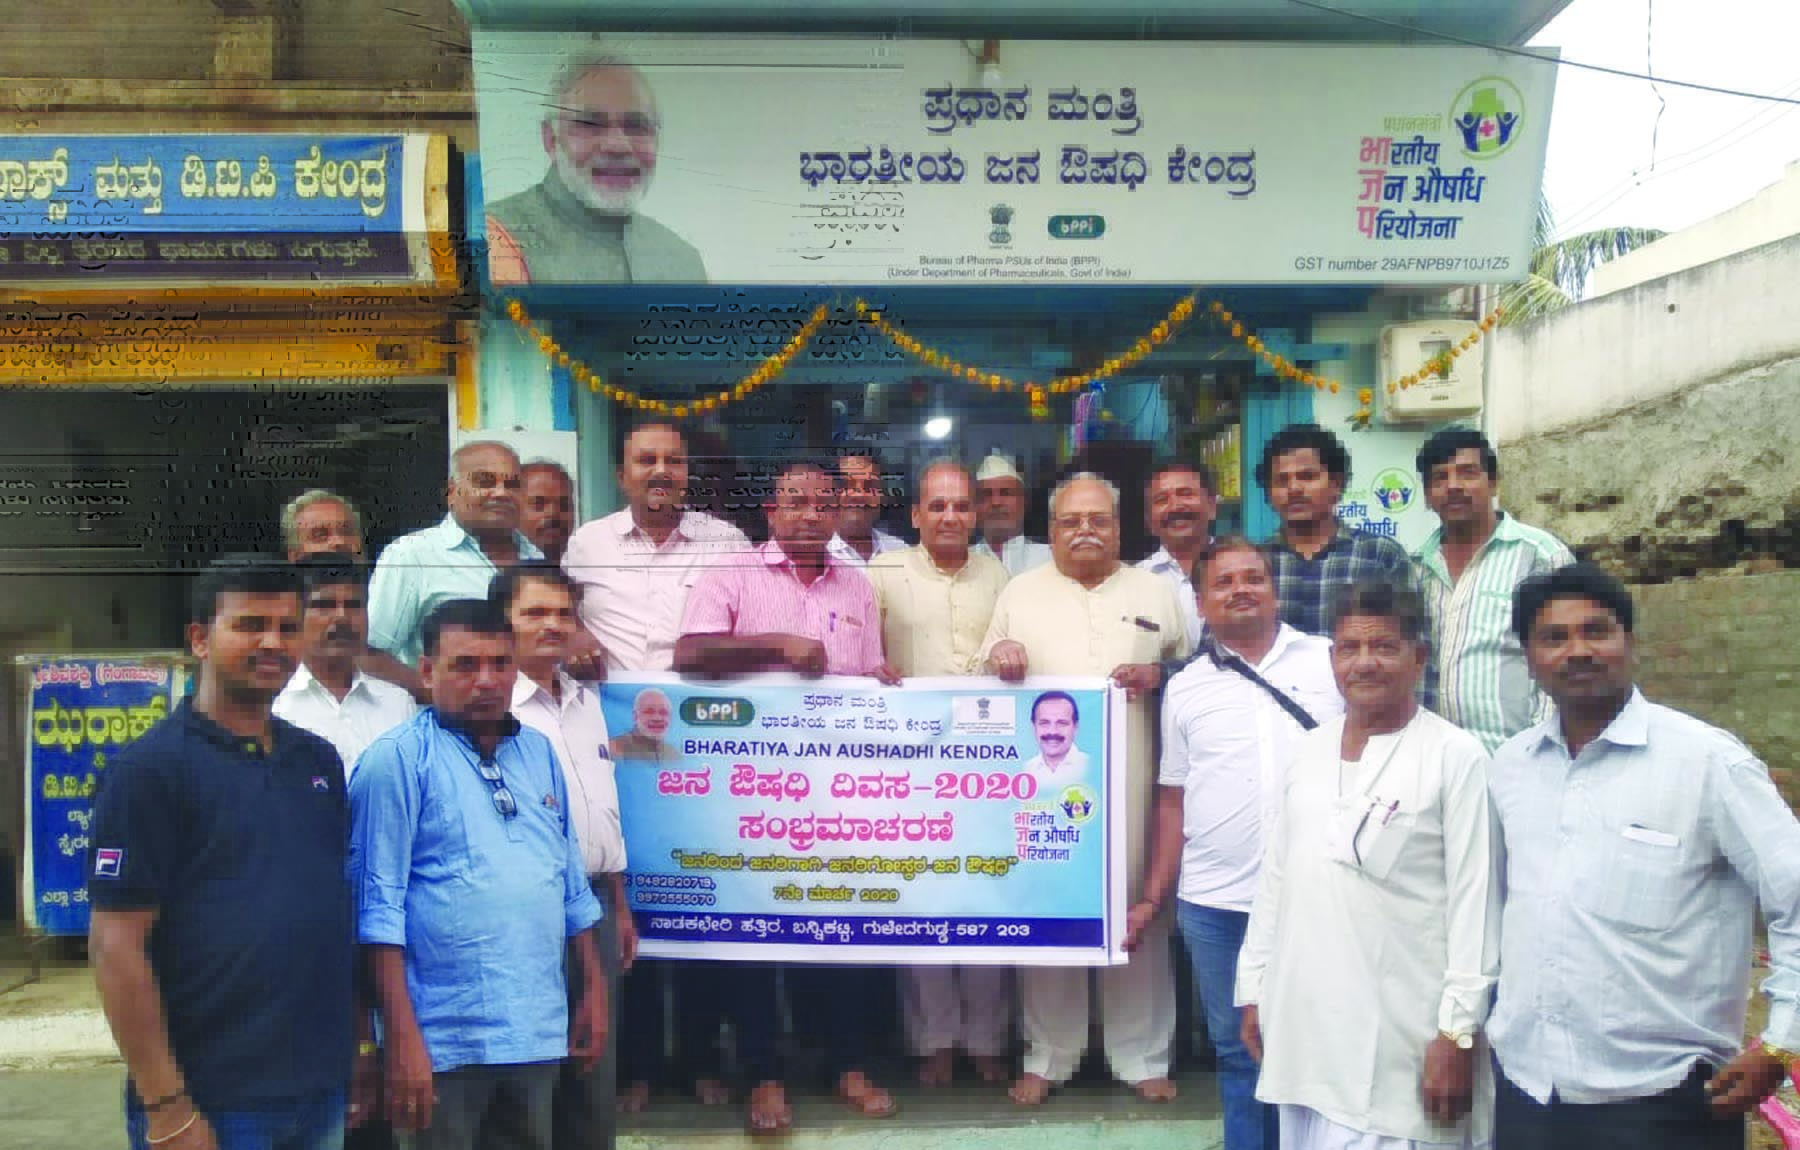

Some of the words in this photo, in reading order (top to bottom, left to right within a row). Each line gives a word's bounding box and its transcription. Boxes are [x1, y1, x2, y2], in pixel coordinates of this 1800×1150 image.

[924, 82, 1029, 133] ಪ್ರಧಾನ
[1048, 85, 1142, 135] ಮಂತ್ರಿ
[1359, 135, 1441, 165] भारतीय
[95, 156, 163, 215] ಮತ್ತು
[294, 145, 388, 218] ಕೇಂದ್ರ
[799, 145, 965, 188] ಭಾರತೀಯ
[986, 148, 1040, 184] ಜನ
[1060, 146, 1147, 190] ಔಷಧಿ
[1168, 147, 1257, 196] ಕೇಂದ್ರ
[1357, 168, 1408, 203] जन
[1411, 167, 1486, 203] औषधि
[1356, 206, 1464, 240] परियोजना
[887, 267, 919, 278] (Under
[922, 267, 976, 278] Department
[978, 267, 987, 278] of
[919, 255, 953, 266] Bureau
[955, 255, 965, 266] of
[967, 255, 1003, 266] Pharma
[1034, 255, 1044, 266] of
[1046, 255, 1068, 266] India
[1070, 255, 1101, 266] (BPPI)
[1294, 256, 1324, 270] GST
[1328, 257, 1377, 270] number
[803, 694, 844, 711] ಪ್ರಧಾನ
[850, 695, 888, 713] ಮಂತ್ರಿ
[761, 715, 826, 729] ಭಾರತೀಯ
[834, 717, 857, 730] ಜನ
[864, 715, 898, 732] ಔಷಧಿ
[906, 718, 943, 736] ಕೇಂದ್ರ
[684, 739, 790, 757] BHARATIYA
[794, 743, 832, 758] JAN
[836, 744, 934, 759] AUSHADHI
[940, 745, 1020, 760] KENDRA
[657, 768, 711, 796] ಜನ
[729, 764, 811, 802] ಔಷಧಿ
[737, 810, 955, 851] ಸಂಭ್ರಮಾಚರಣೆ
[859, 888, 900, 902] 2020
[995, 924, 1031, 936] 203
